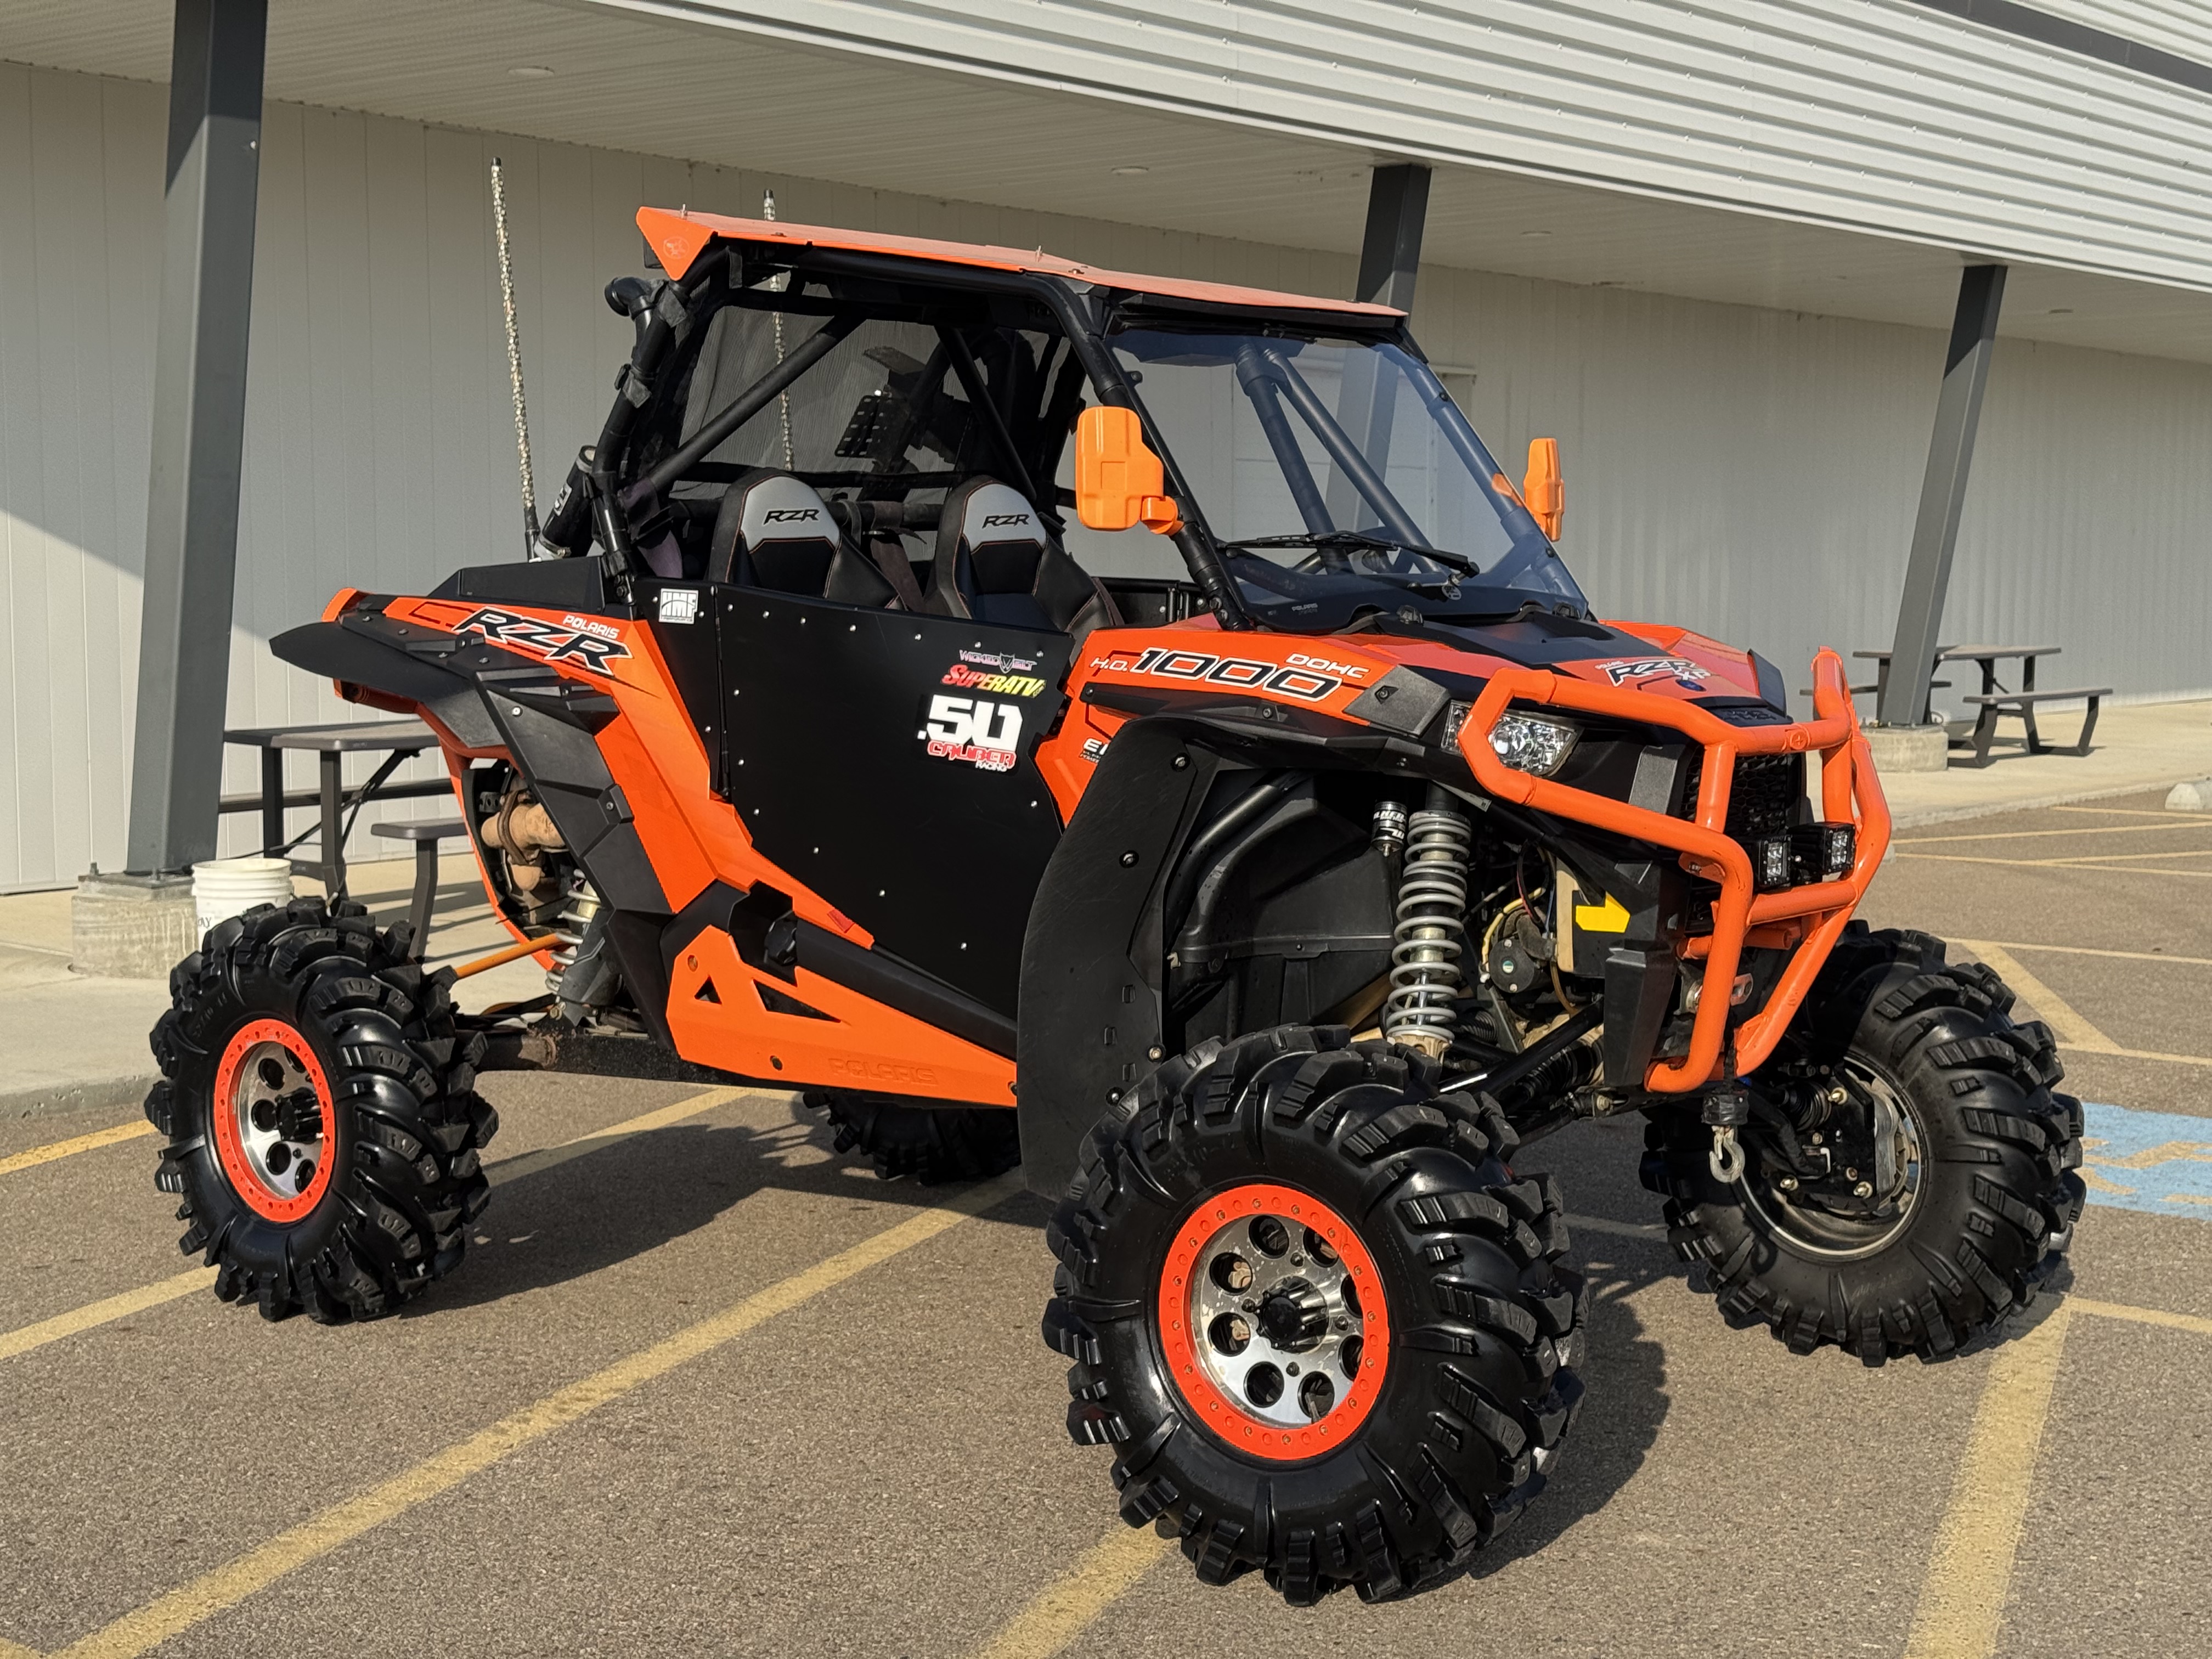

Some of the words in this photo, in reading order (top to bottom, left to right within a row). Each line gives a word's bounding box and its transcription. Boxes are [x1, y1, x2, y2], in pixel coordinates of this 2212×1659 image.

[763, 509, 820, 526] RZR
[982, 513, 1030, 529] RZR
[562, 614, 620, 639] POLARIS
[450, 606, 635, 676] RZR
[1090, 657, 1128, 672] H.O.
[1130, 647, 1342, 702] 1000
[1285, 653, 1370, 679] DOHC
[1605, 658, 1702, 687] RZR
[917, 694, 1023, 752] .50
[927, 741, 1017, 769] CALIBER
[975, 760, 1008, 772] RACING
[828, 1058, 937, 1085] POLARIS
